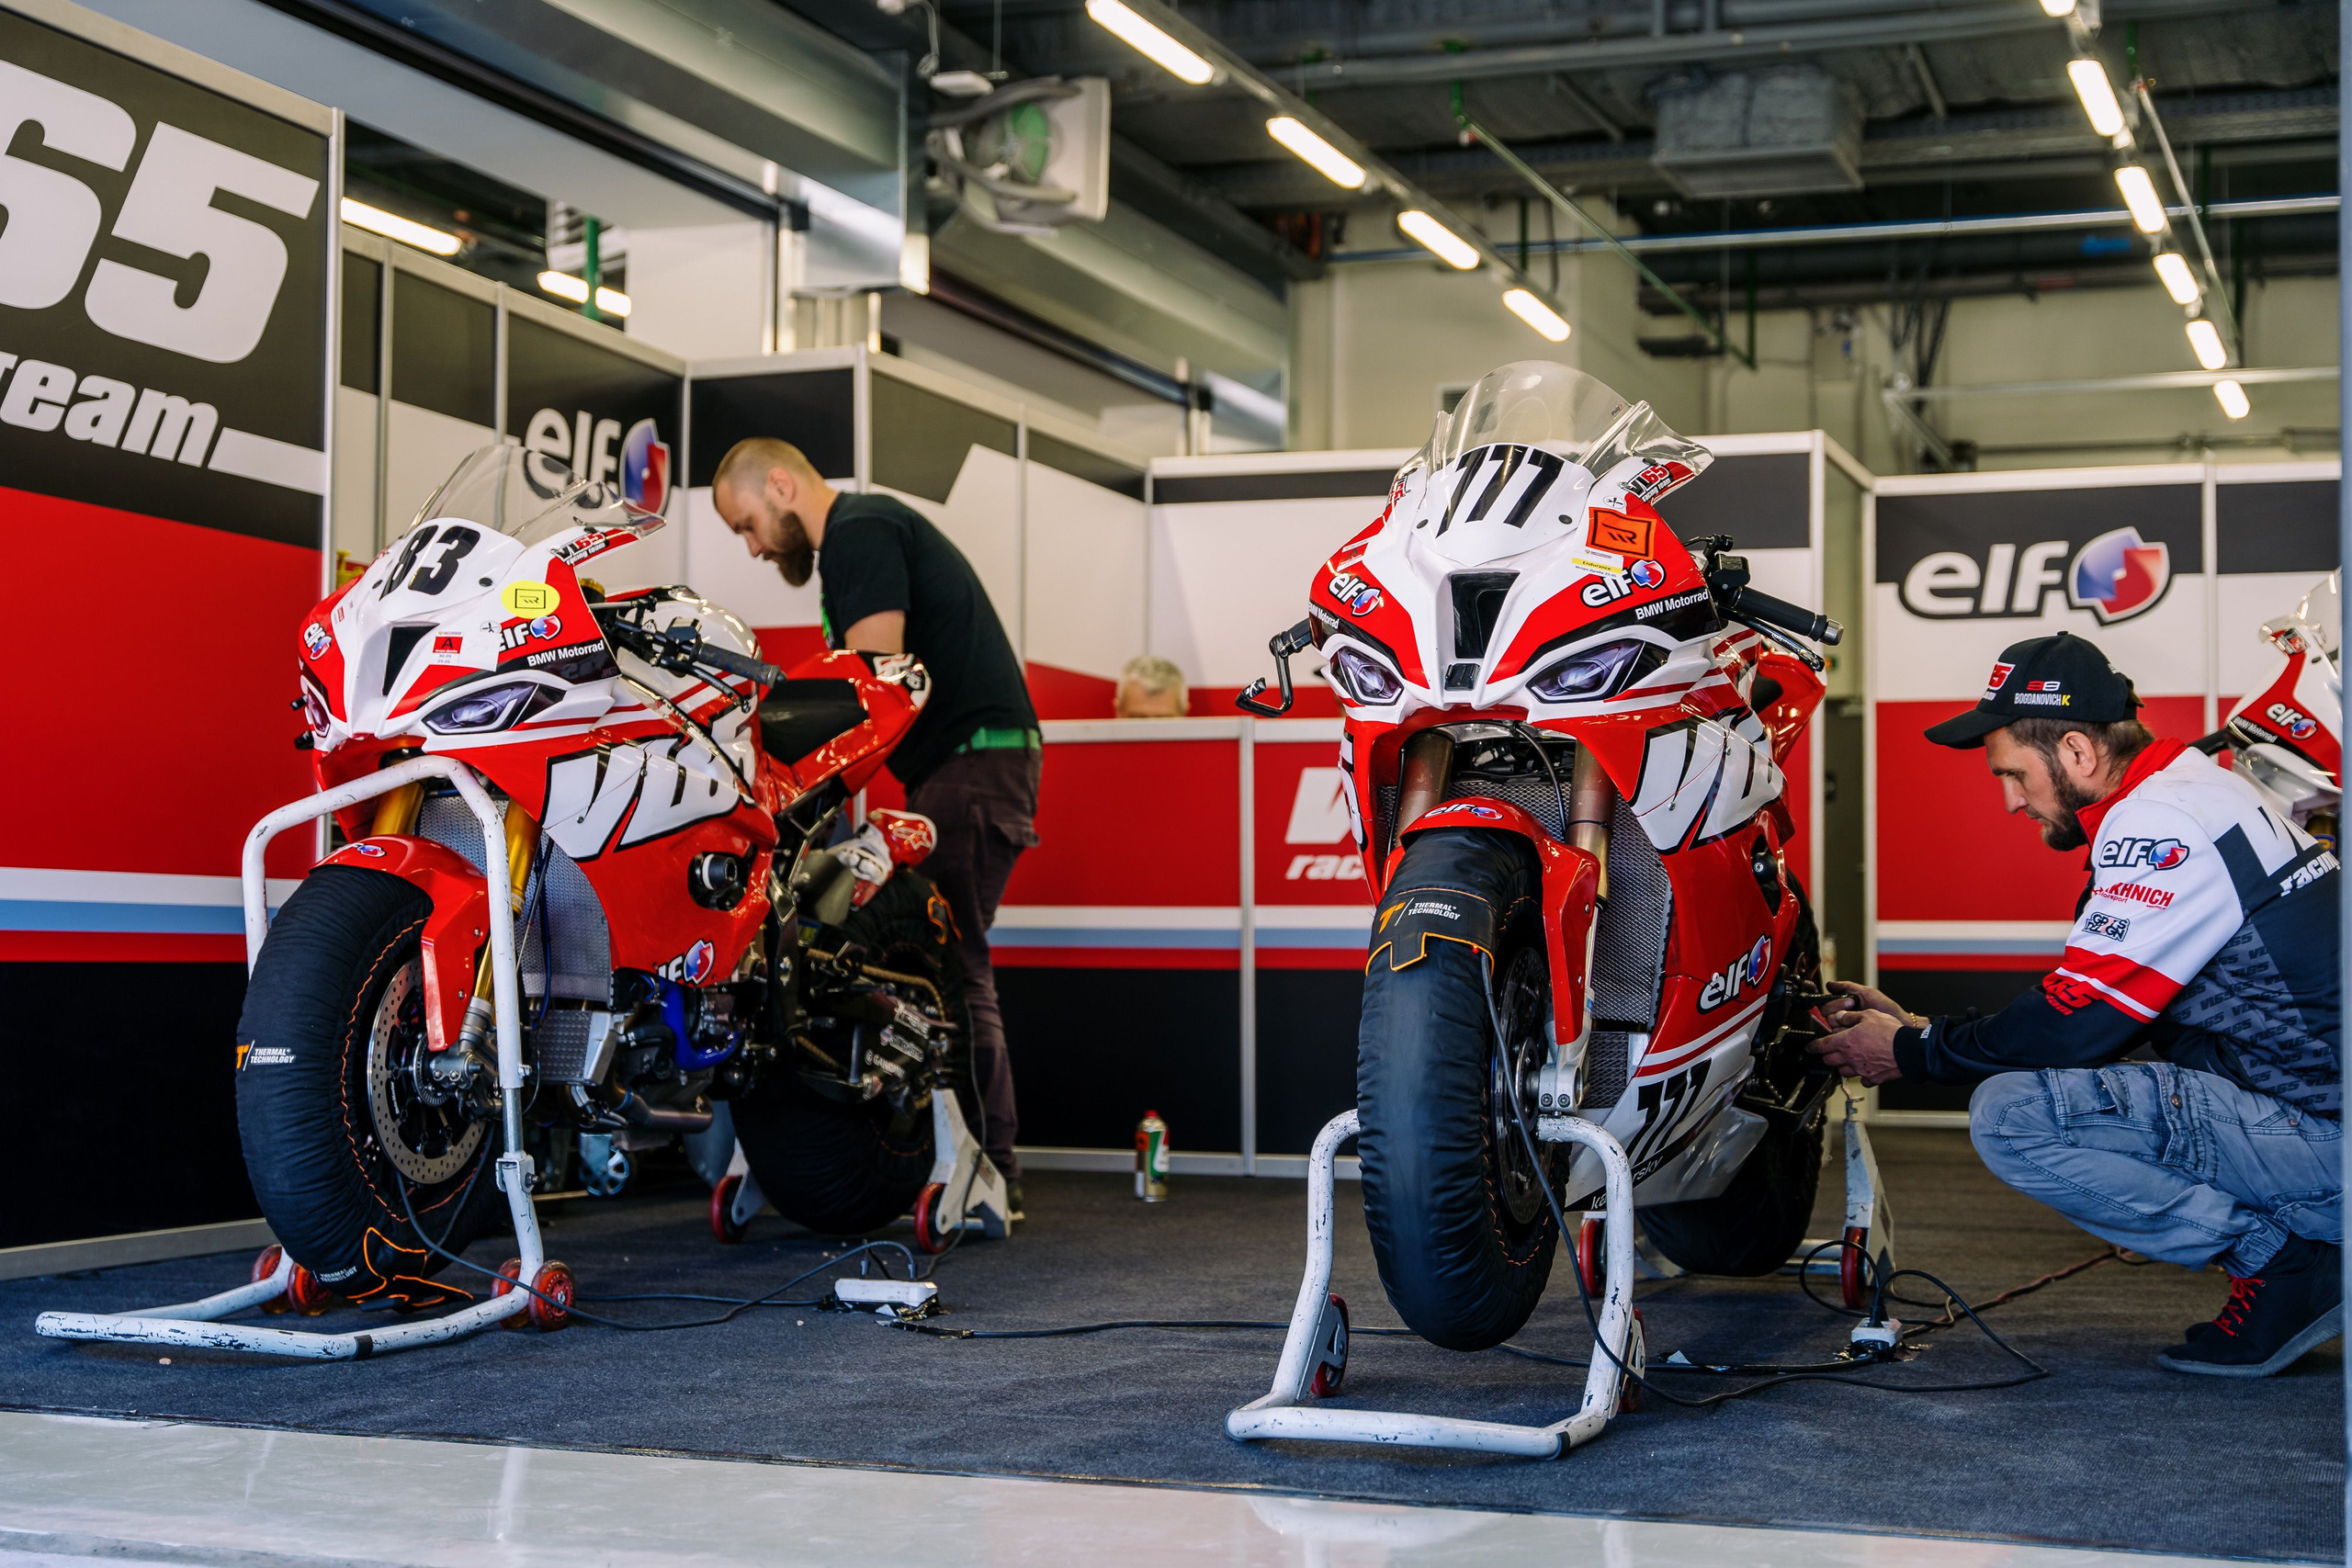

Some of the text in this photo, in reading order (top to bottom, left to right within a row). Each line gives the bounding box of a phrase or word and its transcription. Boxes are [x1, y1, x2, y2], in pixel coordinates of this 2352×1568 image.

[0, 351, 219, 468] eam
[525, 408, 621, 503] elf
[1435, 445, 1565, 539] 777
[379, 525, 481, 601] 83
[1582, 561, 1611, 571] Endurance
[1904, 541, 2069, 615] elf
[1329, 572, 1370, 604] elf
[1582, 568, 1633, 606] elf
[1635, 589, 1709, 620] BMW Motorrad
[527, 641, 605, 668] BMW Motorrad
[2266, 703, 2303, 727] elf
[1285, 854, 1366, 880] rac
[2099, 840, 2153, 864] elf
[1414, 902, 1457, 911] THERMAL
[2092, 882, 2176, 907] KHNICH
[1408, 908, 1461, 920] TECHNOLOGY
[1701, 953, 1749, 1010] elf
[250, 1055, 294, 1064] TECHNOLOGY
[1624, 1057, 1713, 1168] 777
[1591, 1156, 1664, 1211] karsky
